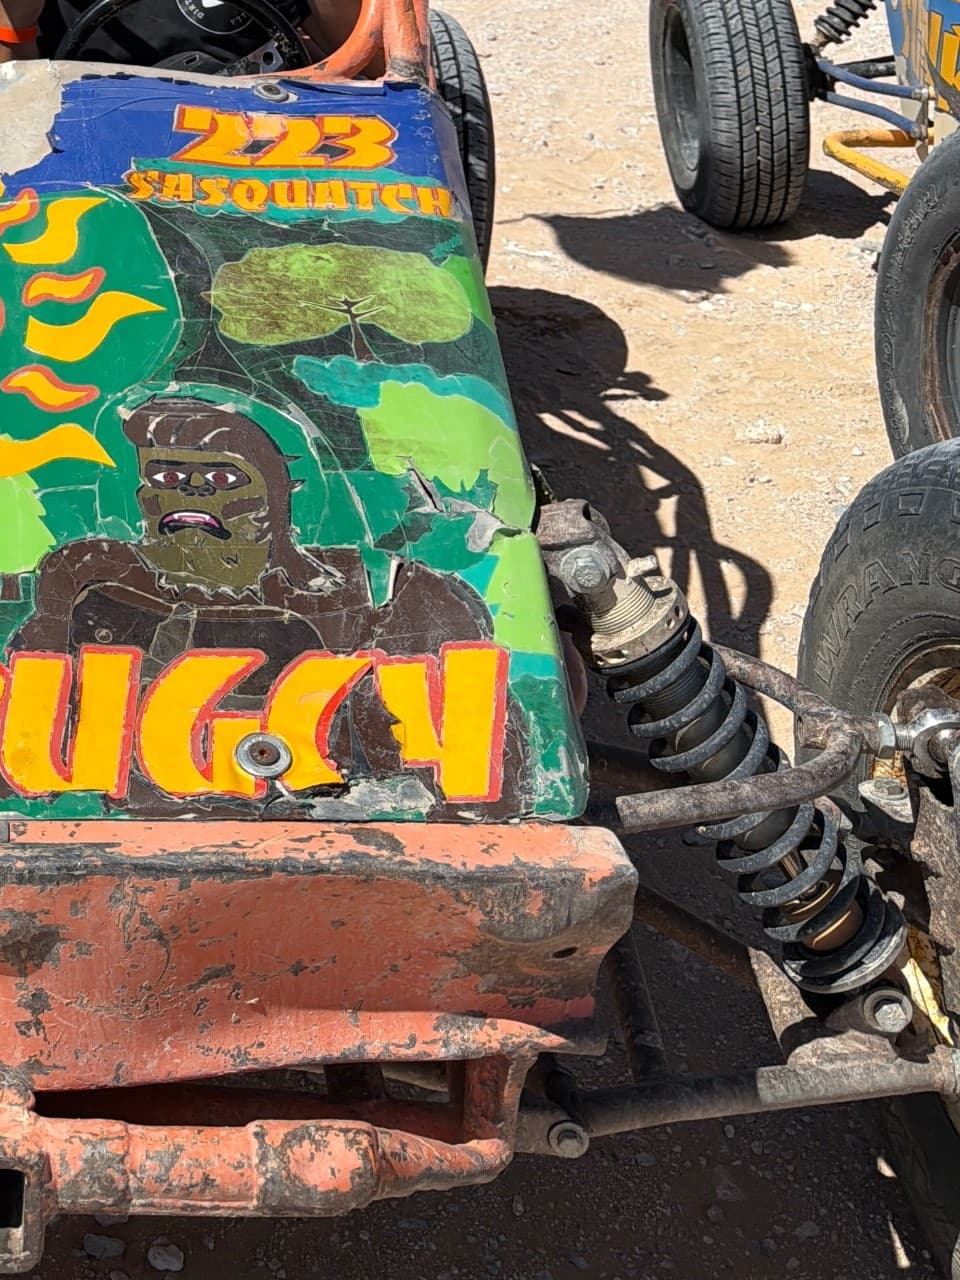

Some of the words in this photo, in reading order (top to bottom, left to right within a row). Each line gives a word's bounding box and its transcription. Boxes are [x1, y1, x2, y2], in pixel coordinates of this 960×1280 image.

[184, 0, 206, 19] DIRT
[172, 103, 399, 170] 223
[124, 169, 453, 217] SASQUATCH
